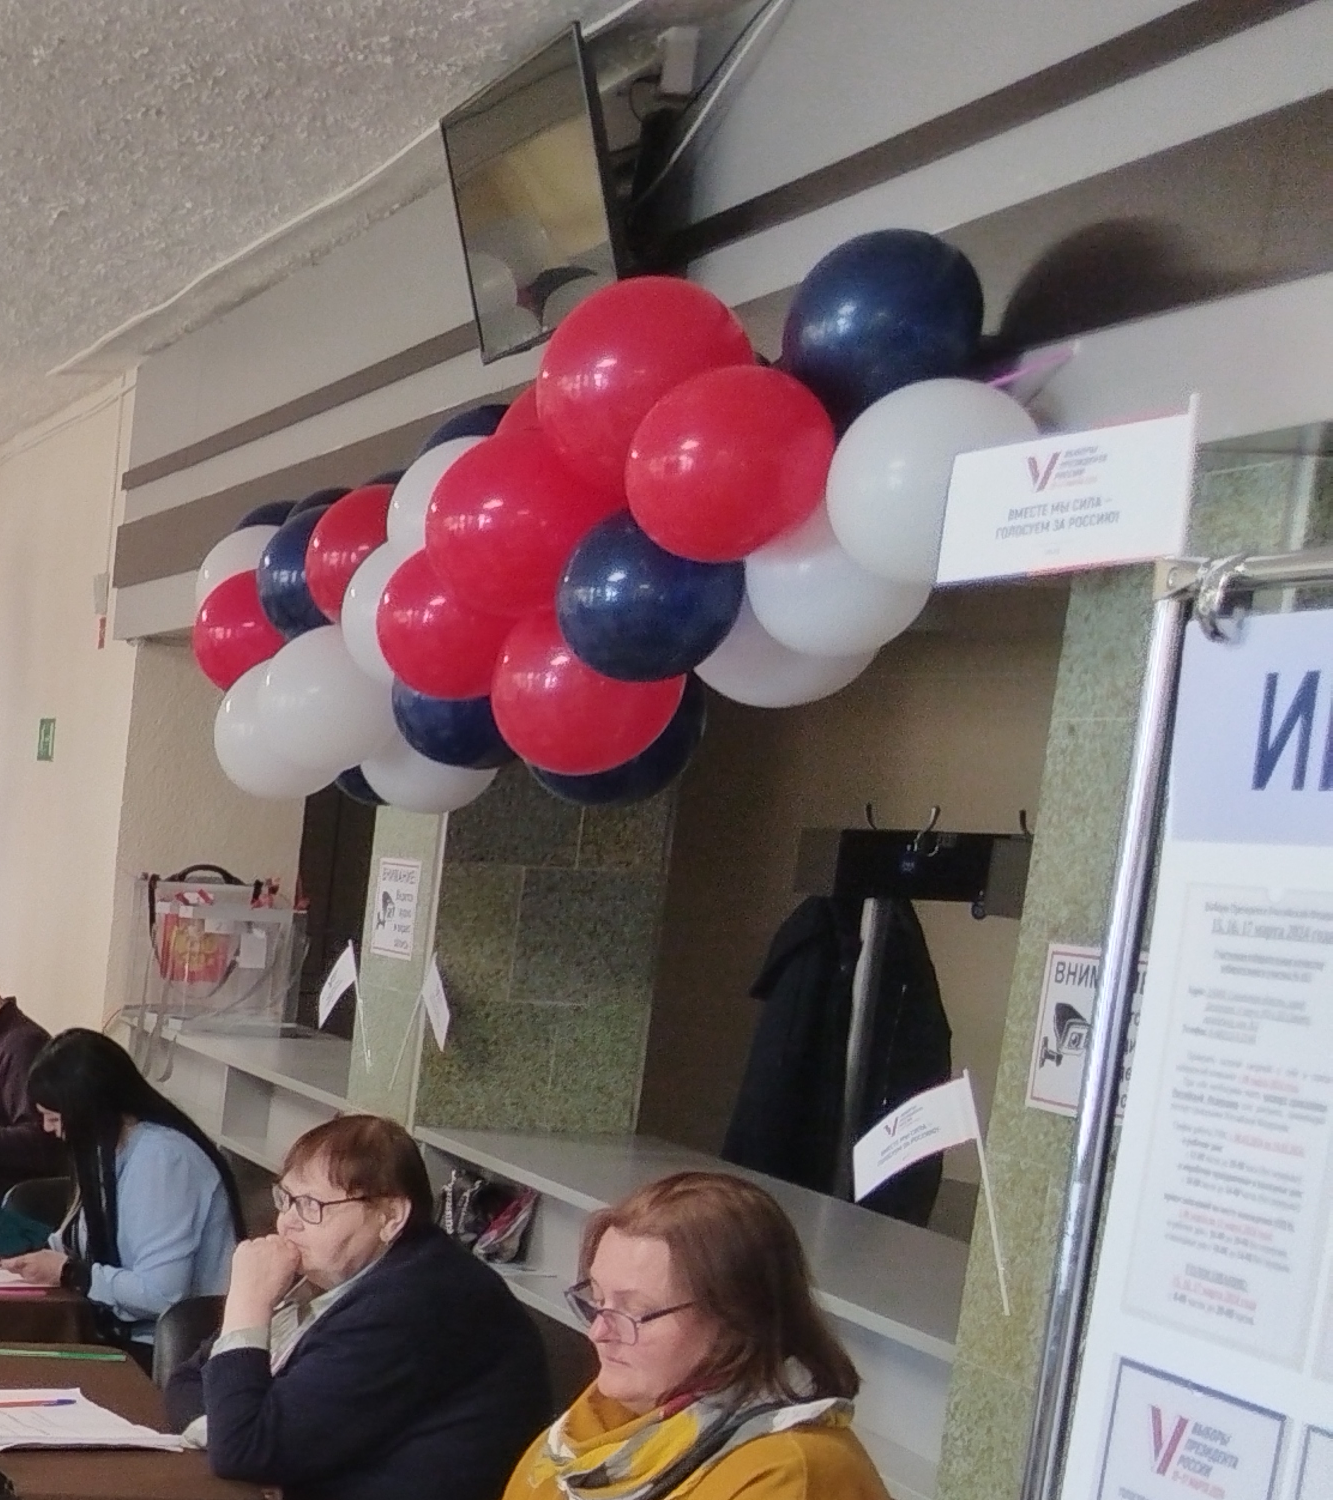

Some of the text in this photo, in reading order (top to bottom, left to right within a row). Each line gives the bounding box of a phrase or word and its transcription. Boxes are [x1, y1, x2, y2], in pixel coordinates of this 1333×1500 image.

[1007, 503, 1048, 522] ВМЕСТЕ
[1050, 501, 1070, 515] МЫ
[1072, 496, 1102, 512] СИЛА
[995, 520, 1051, 540] ГОЛОСУЕМ
[1052, 518, 1065, 532] ЗА
